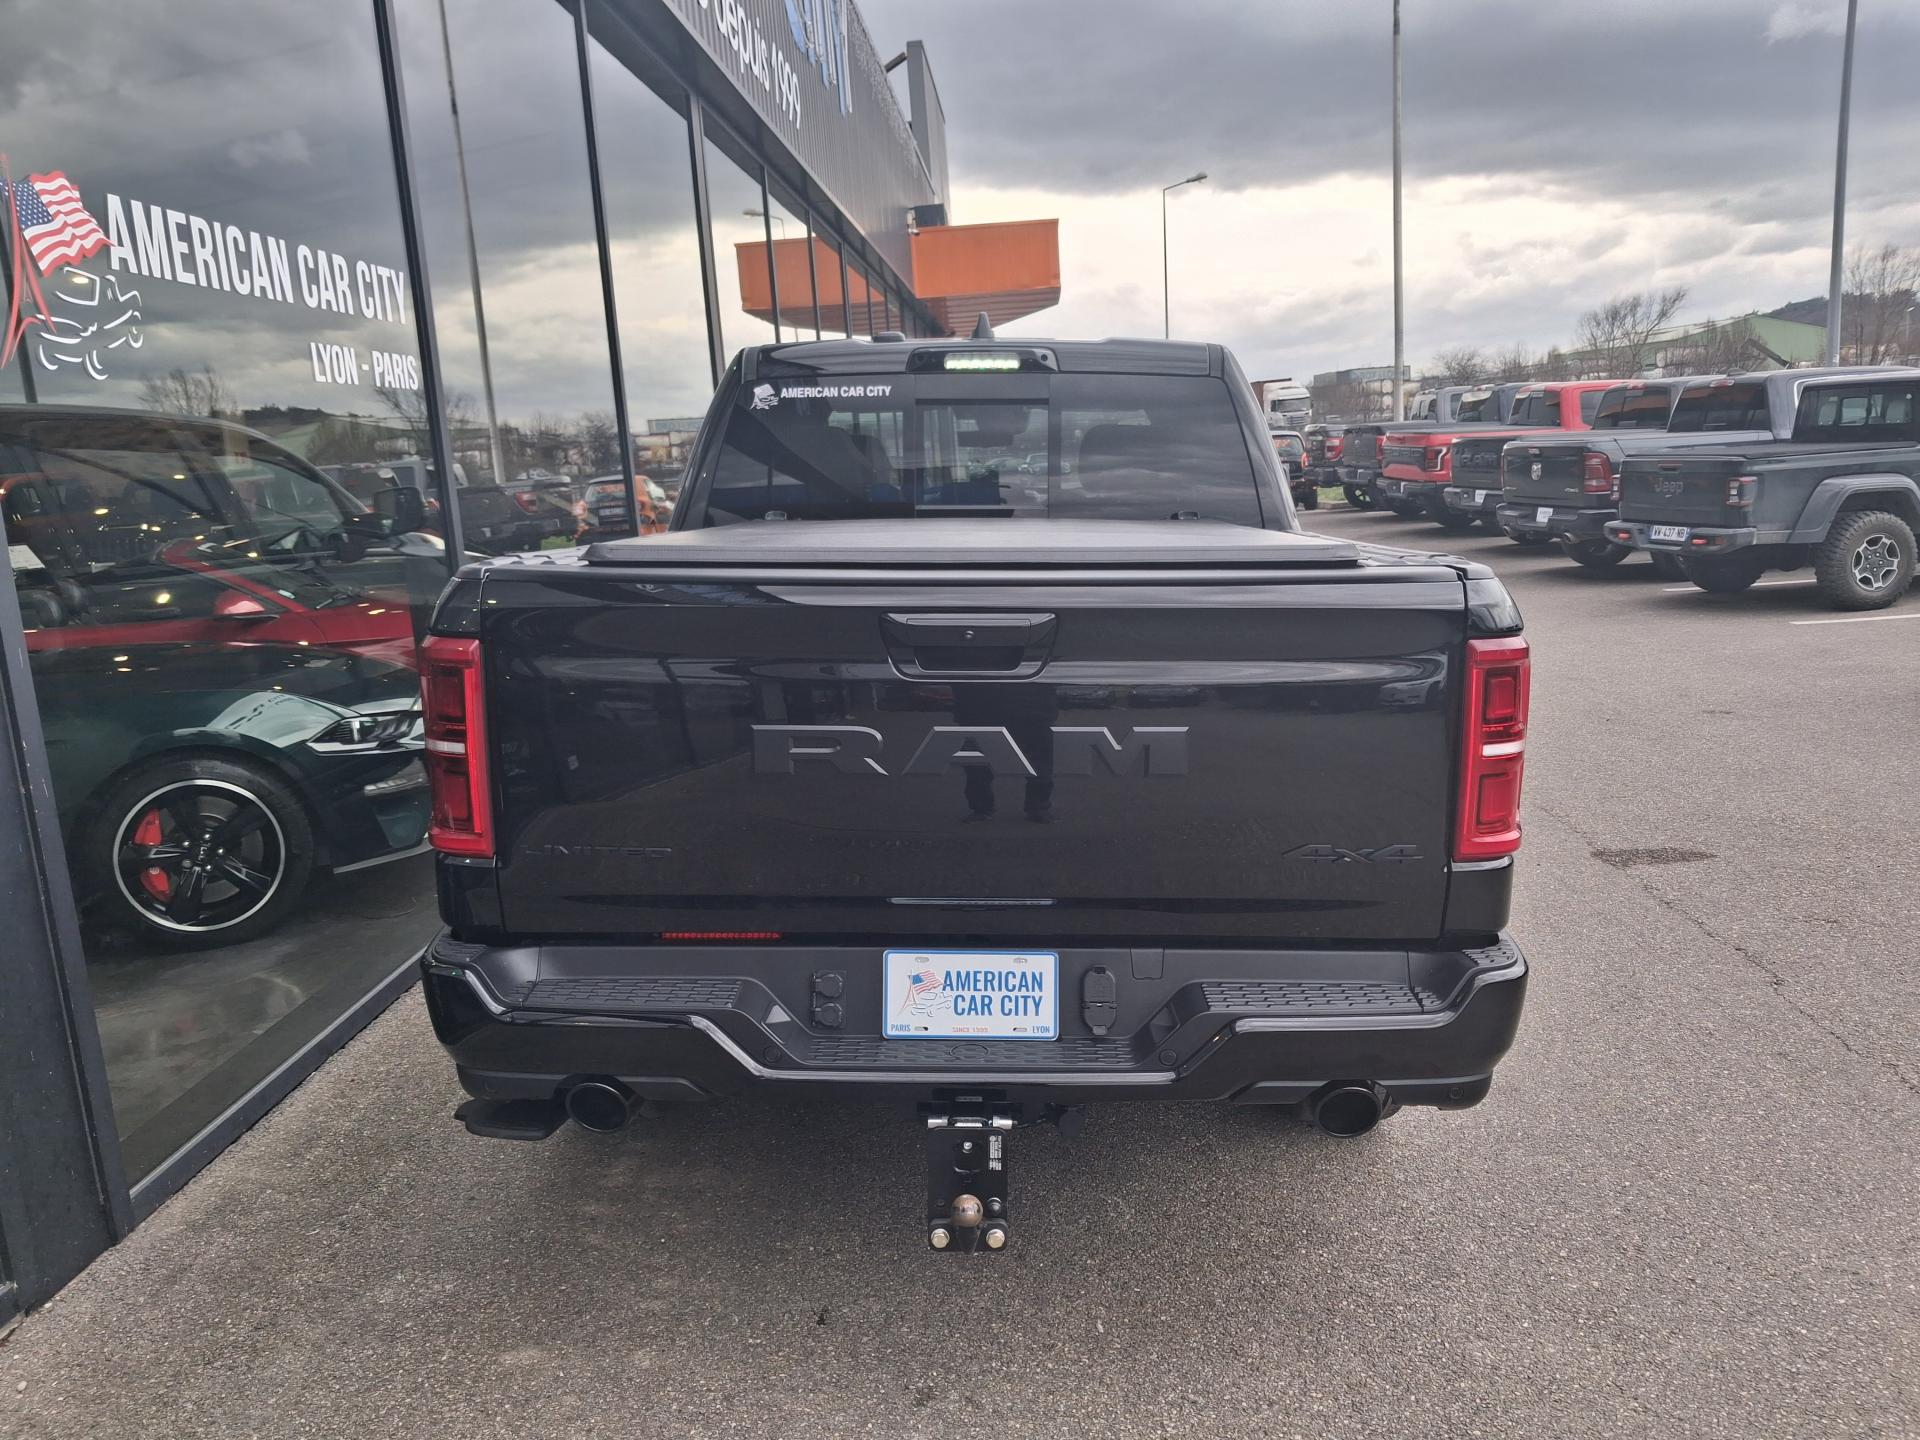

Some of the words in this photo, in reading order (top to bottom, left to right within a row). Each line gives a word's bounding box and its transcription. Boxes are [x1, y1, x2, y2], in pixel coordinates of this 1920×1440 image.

[771, 42, 801, 130] 1999
[106, 193, 294, 304] AMERICAN
[297, 244, 355, 315] CAR
[356, 259, 408, 325] CITY
[310, 342, 359, 385] LYON
[371, 350, 420, 390] PARIS
[780, 387, 839, 399] AMERICAN
[840, 385, 865, 397] CAR
[866, 385, 892, 397] CITY
[1654, 477, 1684, 496] Jeep
[751, 724, 1190, 778] RAM
[942, 970, 1043, 993] AMERICAN
[953, 994, 993, 1017] CAR
[1000, 994, 1043, 1017] CITY
[890, 1023, 911, 1033] PARIS
[1031, 1024, 1050, 1034] LYON
